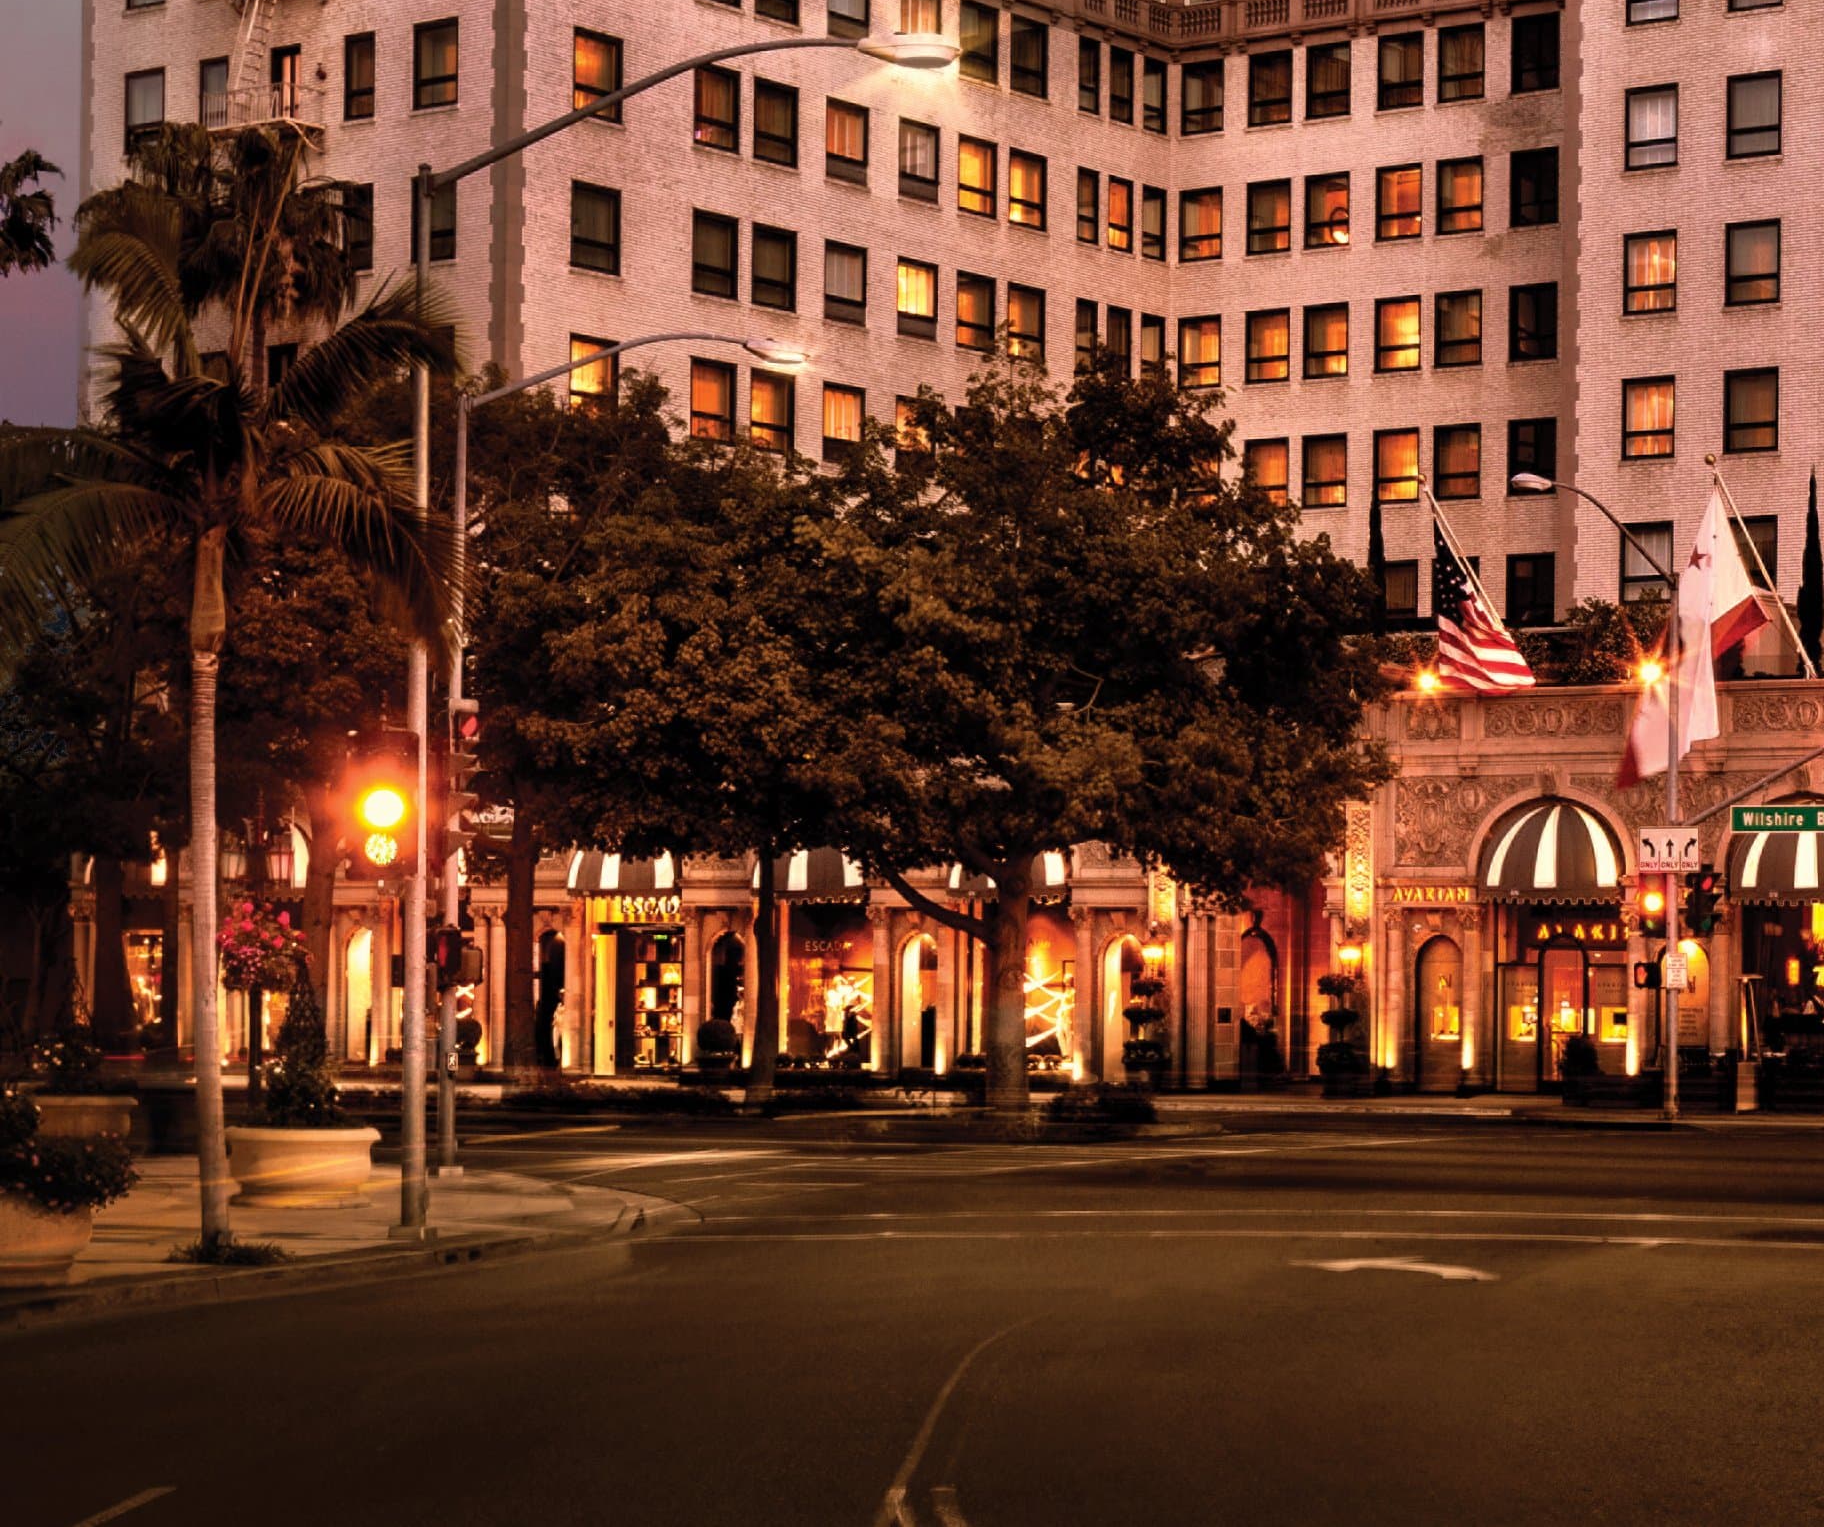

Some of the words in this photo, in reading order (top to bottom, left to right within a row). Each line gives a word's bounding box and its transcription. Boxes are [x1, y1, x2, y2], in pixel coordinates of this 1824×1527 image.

[1743, 811, 1804, 826] Wilshire
[1640, 861, 1658, 869] ONLY
[1661, 861, 1678, 869] ONLY
[1681, 861, 1698, 869] ONLY
[622, 895, 681, 915] ESCAD
[804, 940, 853, 952] ESCAD
